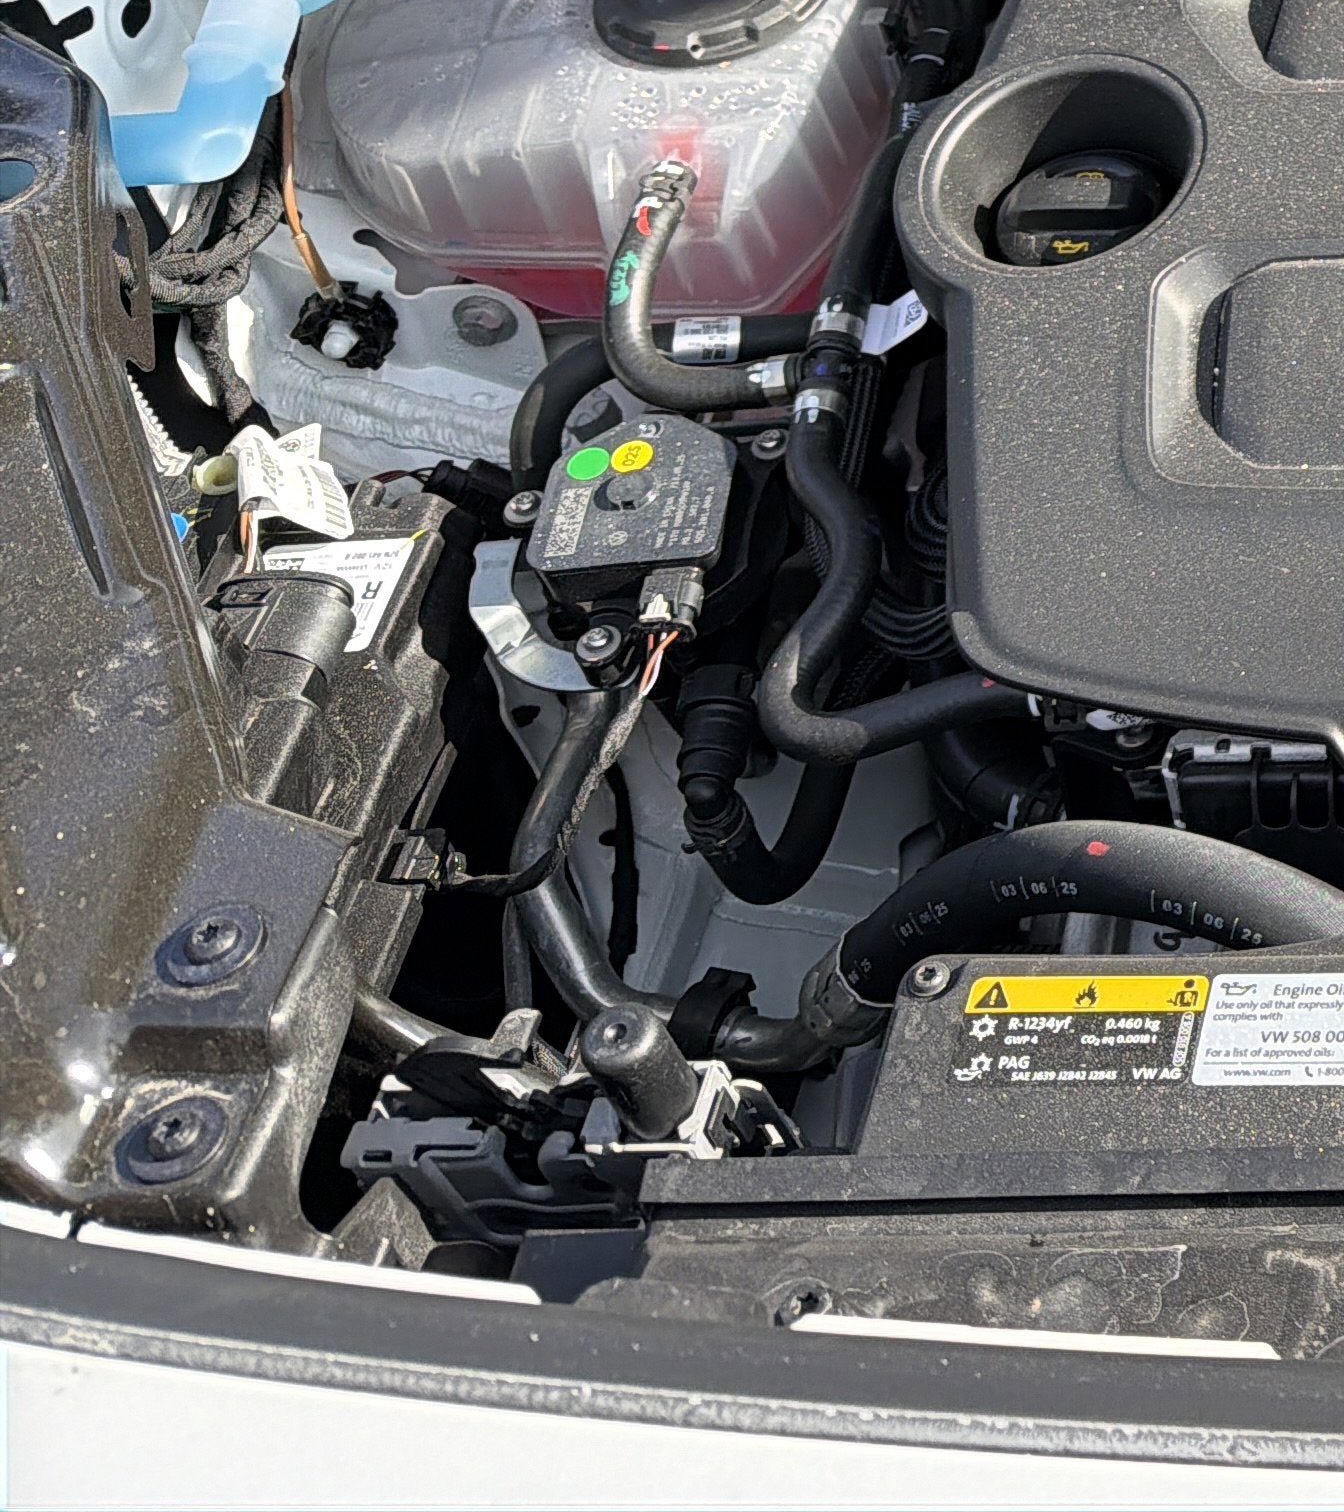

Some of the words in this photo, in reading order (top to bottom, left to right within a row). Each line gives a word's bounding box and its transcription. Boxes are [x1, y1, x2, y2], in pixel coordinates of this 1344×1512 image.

[1162, 900, 1183, 915] 03
[1273, 983, 1323, 999] Engine
[1215, 1000, 1235, 1009] Use
[1236, 1000, 1259, 1011] only
[1260, 999, 1273, 1009] oil
[1274, 999, 1295, 1009] that
[1298, 999, 1344, 1011] expressly
[1213, 1012, 1257, 1023] complies
[1260, 1012, 1283, 1021] with
[1008, 1016, 1072, 1033] R-1234yf
[1105, 1017, 1142, 1030] 0.460
[1145, 1017, 1161, 1032] kg
[1261, 1030, 1289, 1043] VW
[1292, 1030, 1321, 1043] 508
[1205, 1048, 1222, 1057] For
[1232, 1048, 1248, 1057] list
[1250, 1047, 1262, 1057] of
[1264, 1047, 1312, 1059] approved
[998, 1056, 1030, 1069] PAG
[1132, 1068, 1158, 1079] VW
[1160, 1068, 1182, 1079] AG
